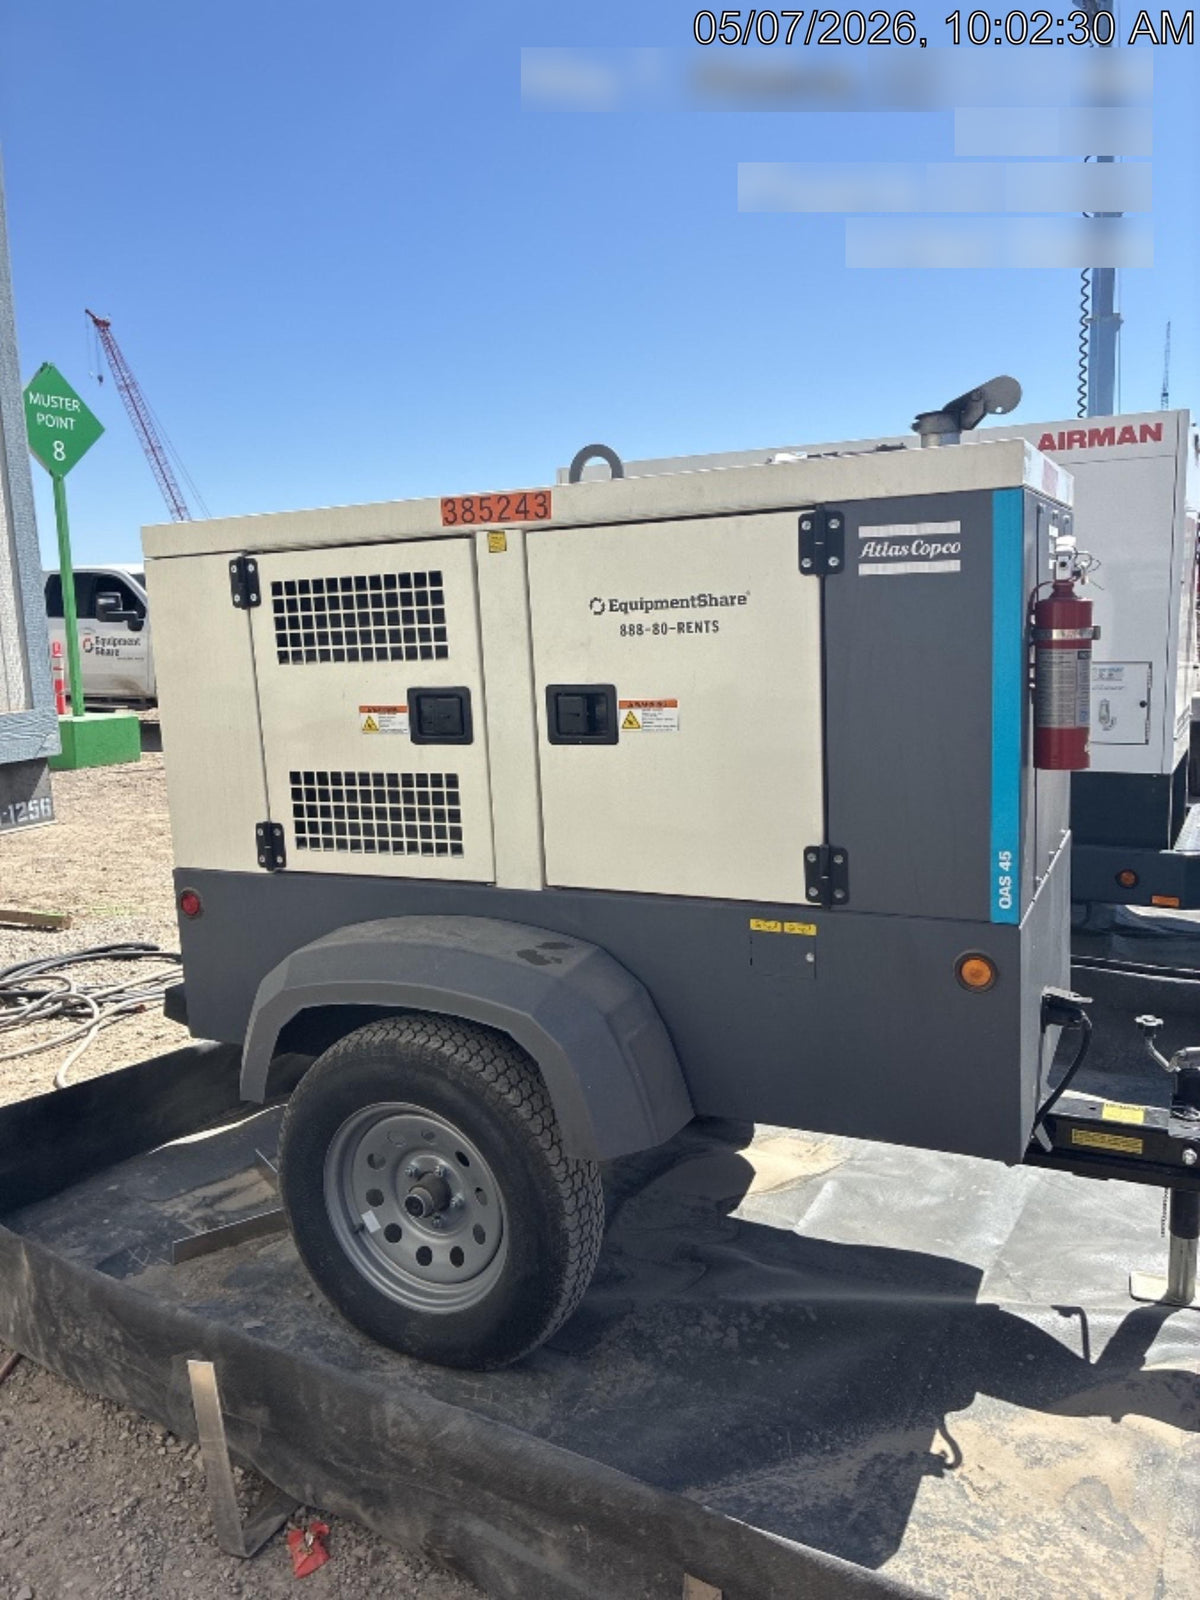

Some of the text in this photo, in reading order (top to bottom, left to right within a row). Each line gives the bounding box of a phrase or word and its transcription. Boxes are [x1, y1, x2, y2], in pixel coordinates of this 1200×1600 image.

[29, 391, 81, 412] MUSTER
[37, 412, 76, 431] POINT
[1038, 422, 1163, 451] AIRMAN
[53, 440, 66, 461] 8
[442, 491, 549, 526] 385243
[859, 538, 961, 559] Atlas Copco
[620, 620, 720, 637] 888-80-RENTS
[998, 850, 1012, 872] 45
